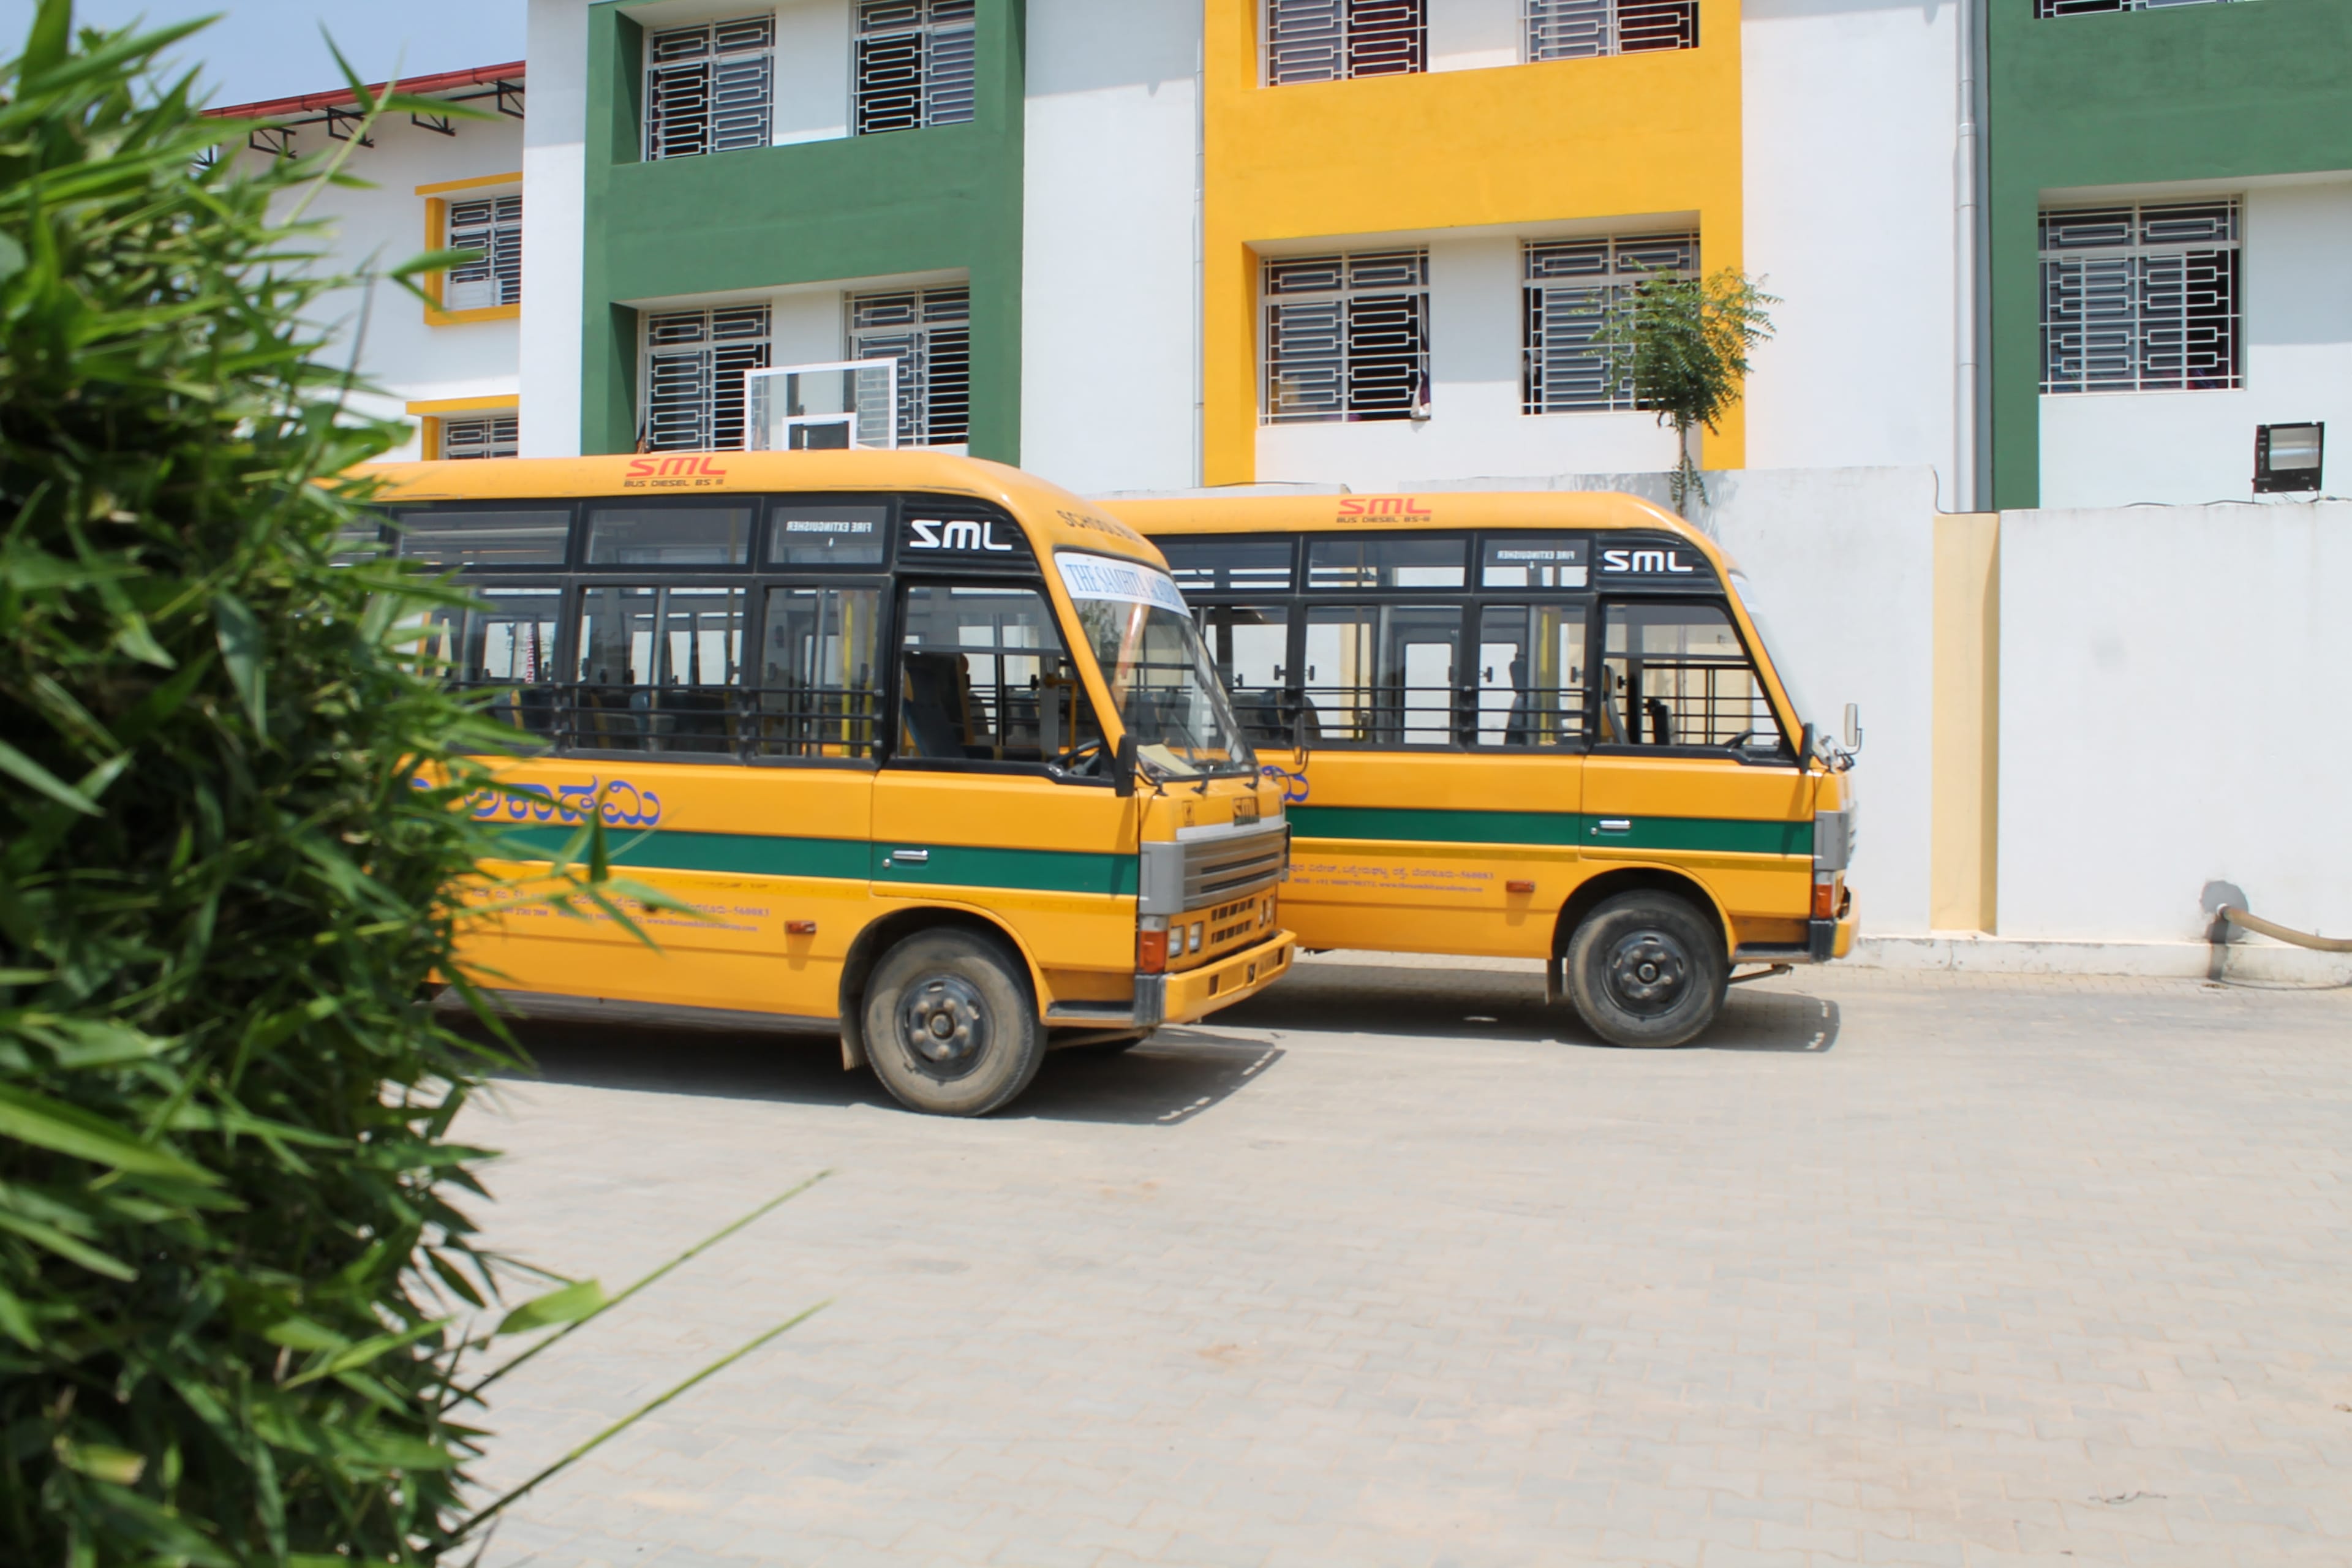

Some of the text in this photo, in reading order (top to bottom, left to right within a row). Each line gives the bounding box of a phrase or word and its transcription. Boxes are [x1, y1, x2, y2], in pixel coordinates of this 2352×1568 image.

[626, 456, 726, 477] SML
[1338, 498, 1431, 515] SML
[909, 519, 1012, 551] SML
[1604, 550, 1694, 573] SML
[1065, 564, 1100, 592] THE
